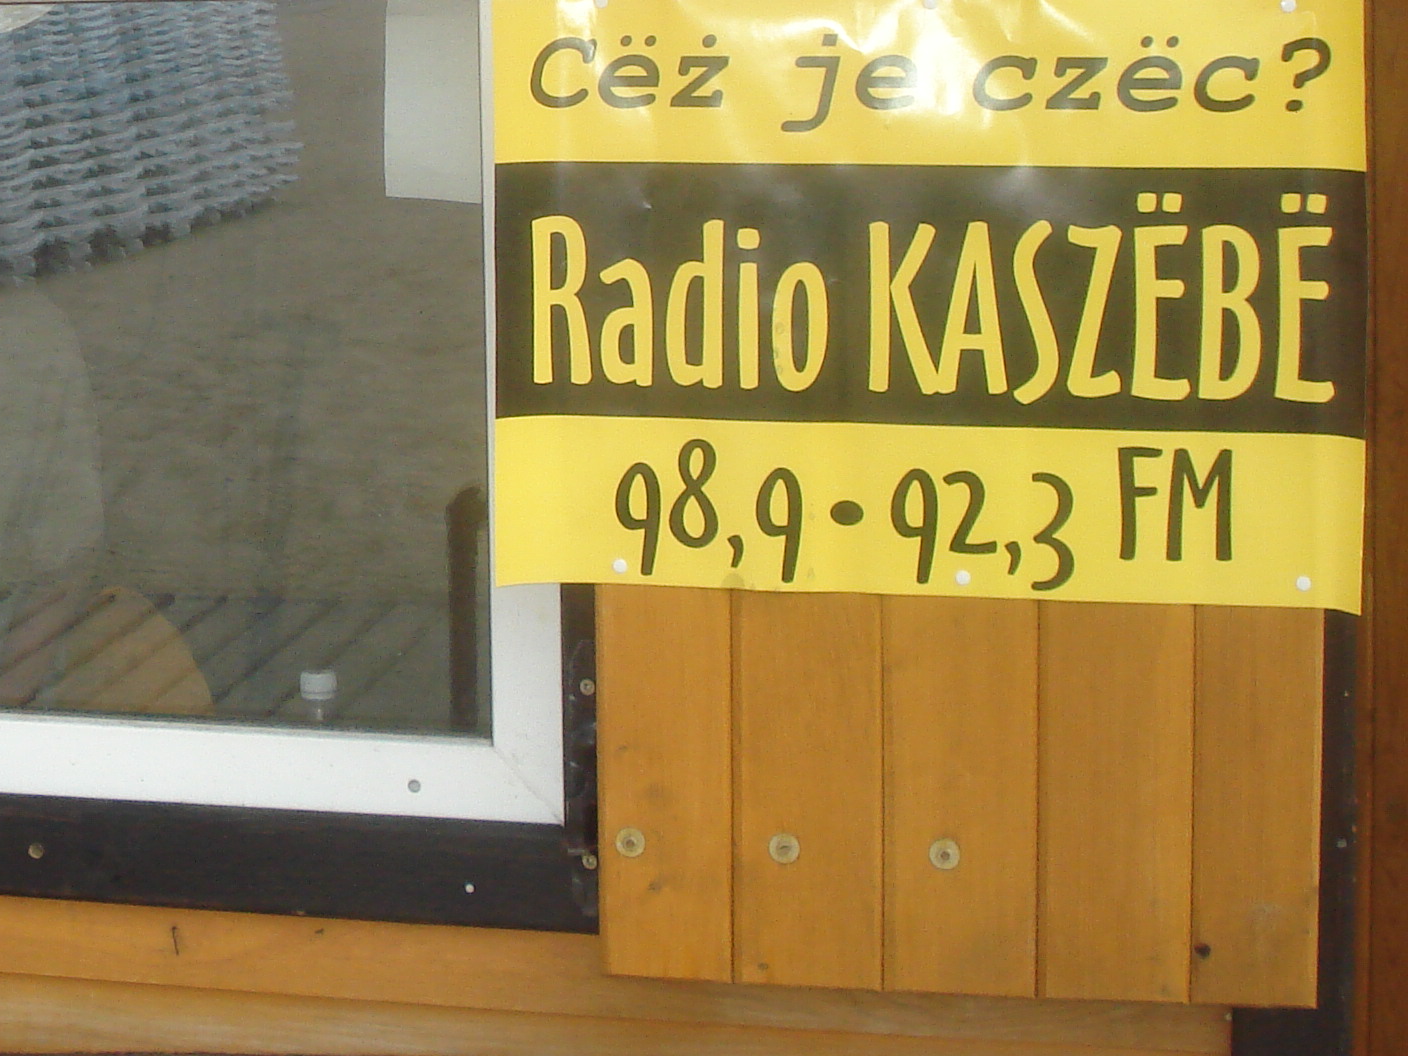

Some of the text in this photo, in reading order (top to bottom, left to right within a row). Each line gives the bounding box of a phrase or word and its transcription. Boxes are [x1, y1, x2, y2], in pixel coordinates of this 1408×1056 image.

[528, 32, 1332, 133] Cëż je czëc?
[530, 191, 1336, 406] Radio KASZËBË
[613, 437, 1234, 592] 98,9 92,3 FM
